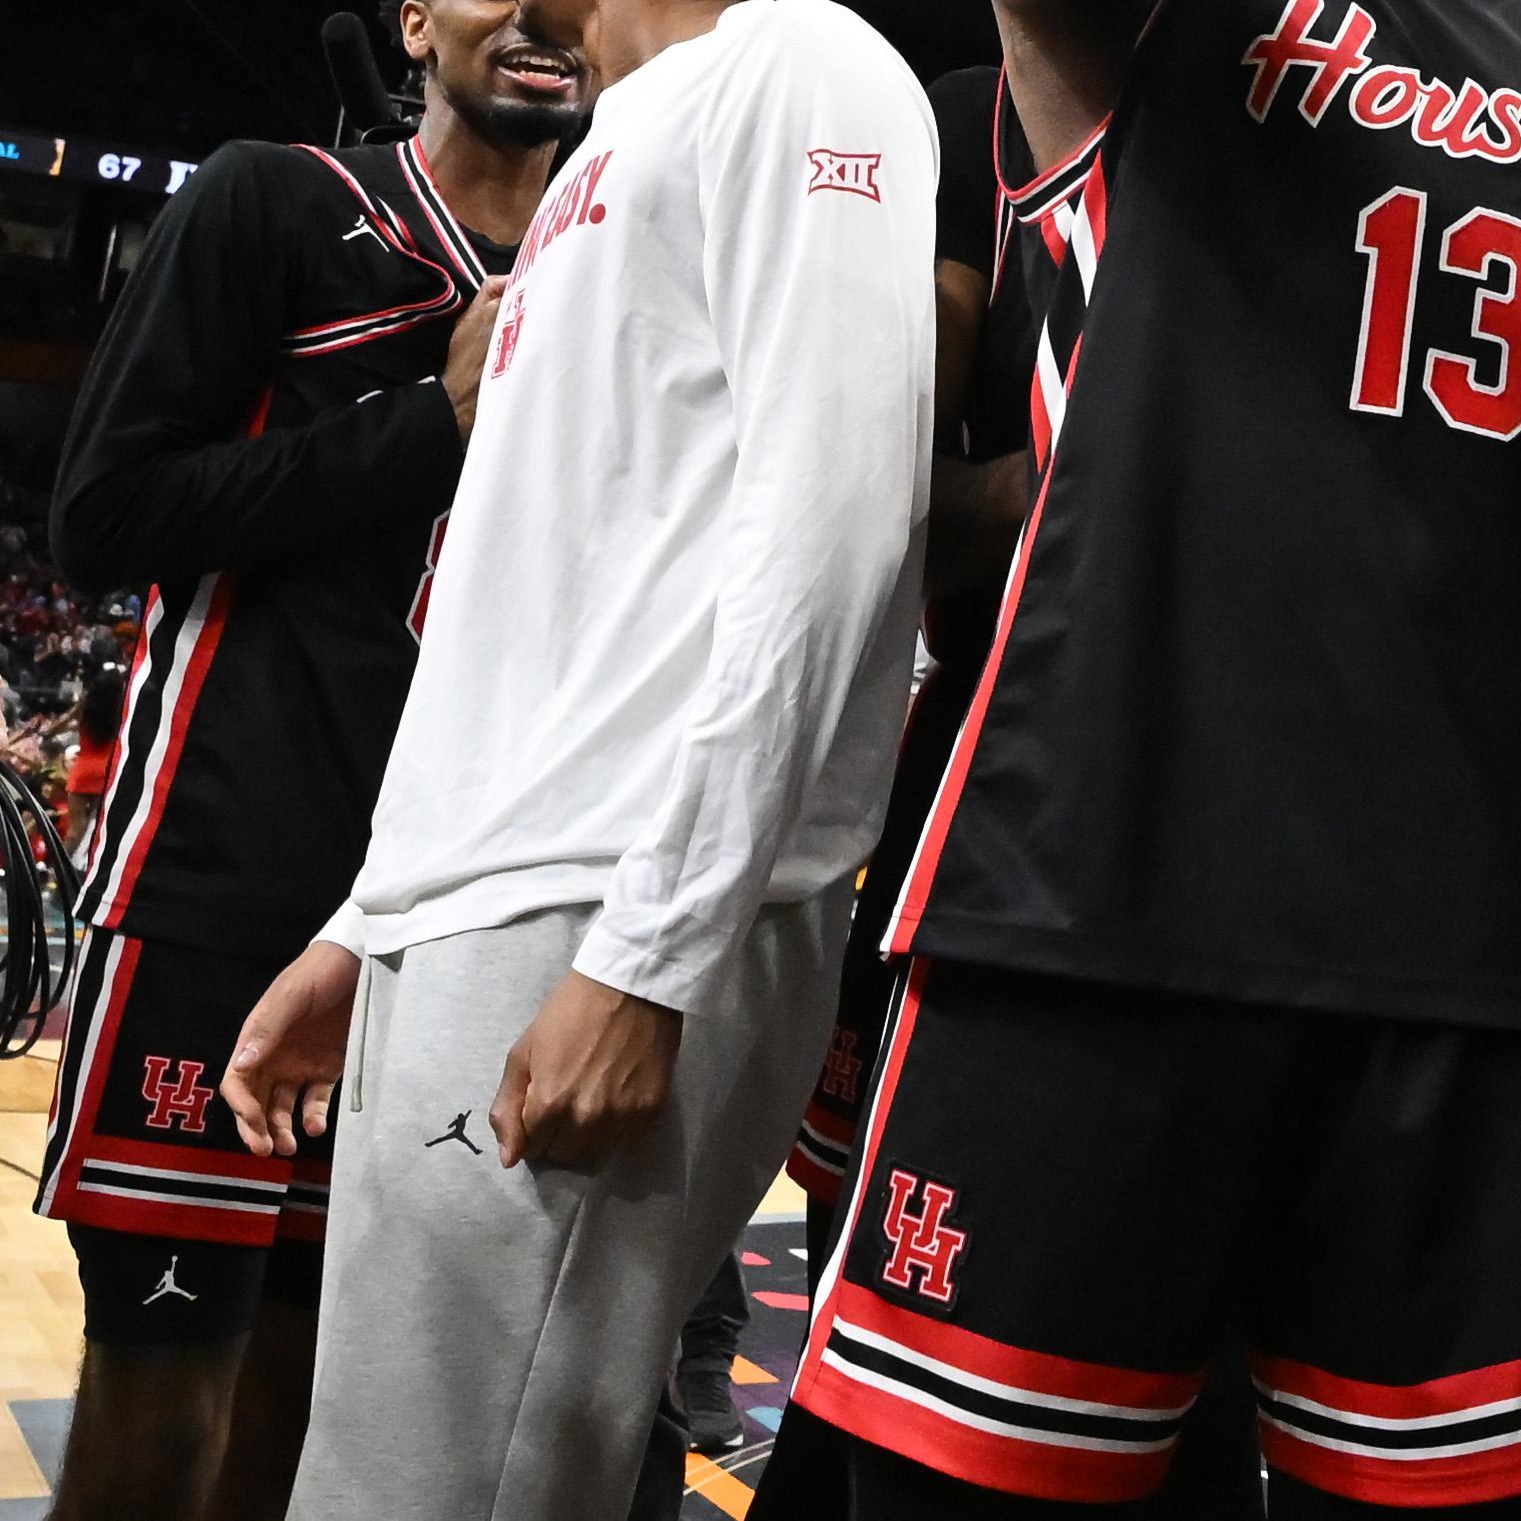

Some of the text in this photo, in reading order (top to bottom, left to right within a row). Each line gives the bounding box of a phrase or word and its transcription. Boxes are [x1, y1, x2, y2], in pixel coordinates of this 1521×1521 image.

[98, 153, 142, 182] 67
[142, 1055, 214, 1133] UH
[883, 1169, 968, 1302] UH
